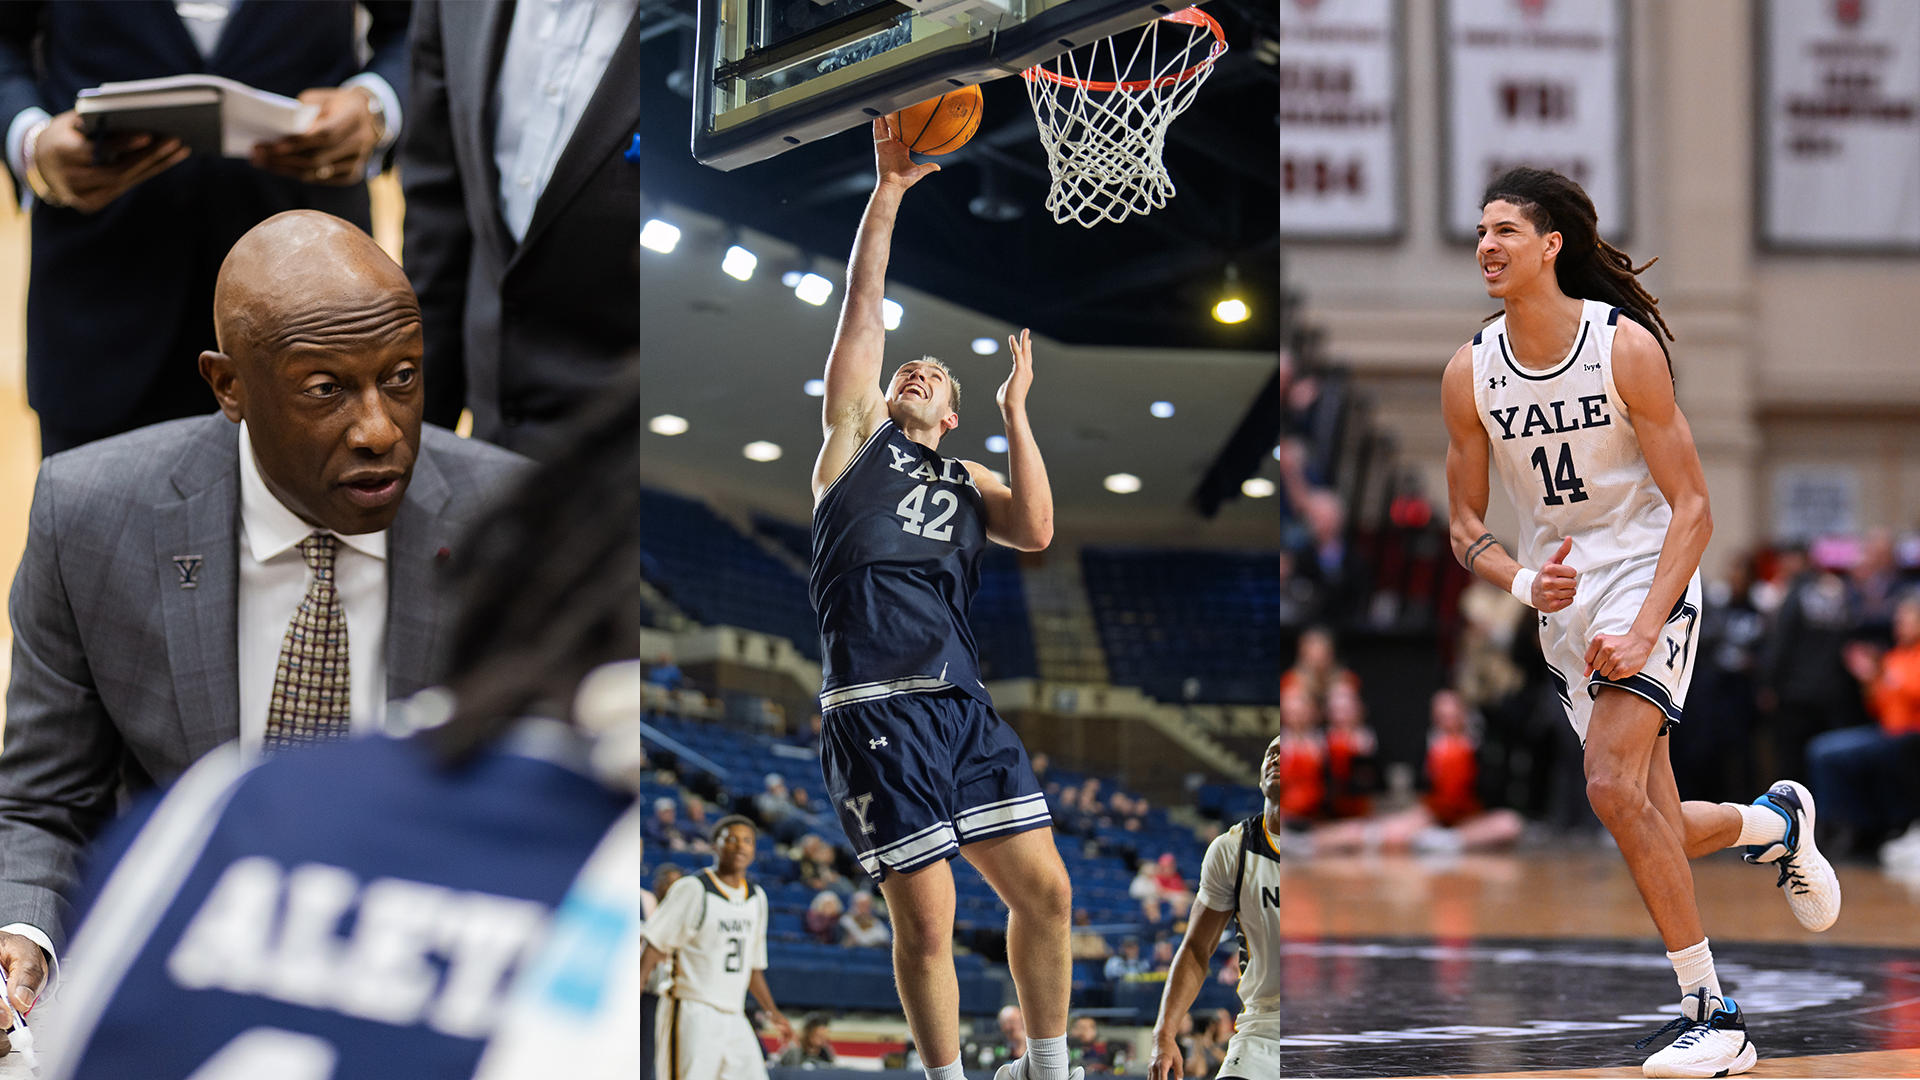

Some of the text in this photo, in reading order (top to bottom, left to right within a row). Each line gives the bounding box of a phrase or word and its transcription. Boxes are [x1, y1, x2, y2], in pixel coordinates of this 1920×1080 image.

[1489, 394, 1611, 440] YALE
[1531, 442, 1589, 506] 14
[896, 484, 958, 542] 42
[172, 554, 203, 590] Y
[1666, 635, 1681, 671] Y
[842, 792, 876, 835] Y
[1262, 886, 1280, 908] N
[725, 937, 746, 973] 21
